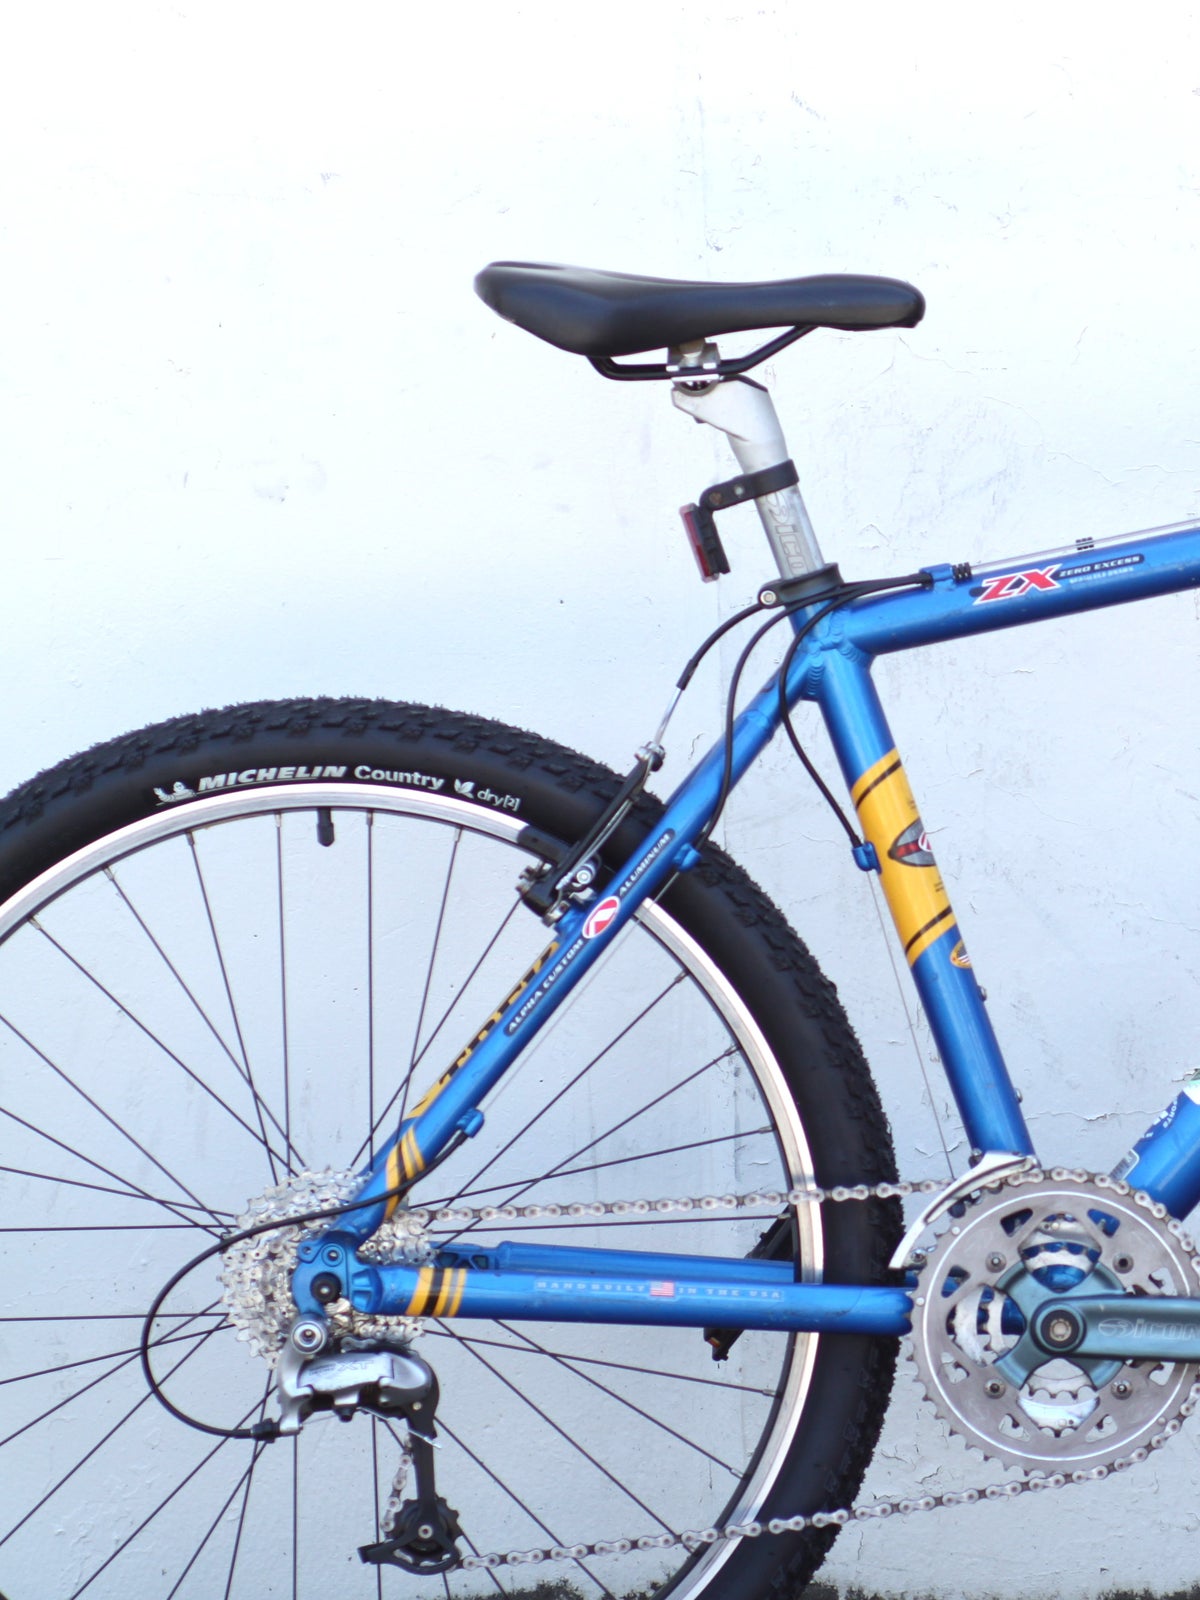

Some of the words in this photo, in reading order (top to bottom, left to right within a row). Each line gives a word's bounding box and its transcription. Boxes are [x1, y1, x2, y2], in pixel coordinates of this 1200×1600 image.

[972, 563, 1063, 605] ZX
[1059, 566, 1091, 578] ZERO
[1094, 555, 1141, 571] EXCESS
[198, 765, 347, 792] MICHELIN
[353, 765, 445, 790] Country
[508, 990, 543, 1033] ALPHA
[543, 939, 584, 989] CUSTOM
[618, 832, 671, 897] ALUMINUM
